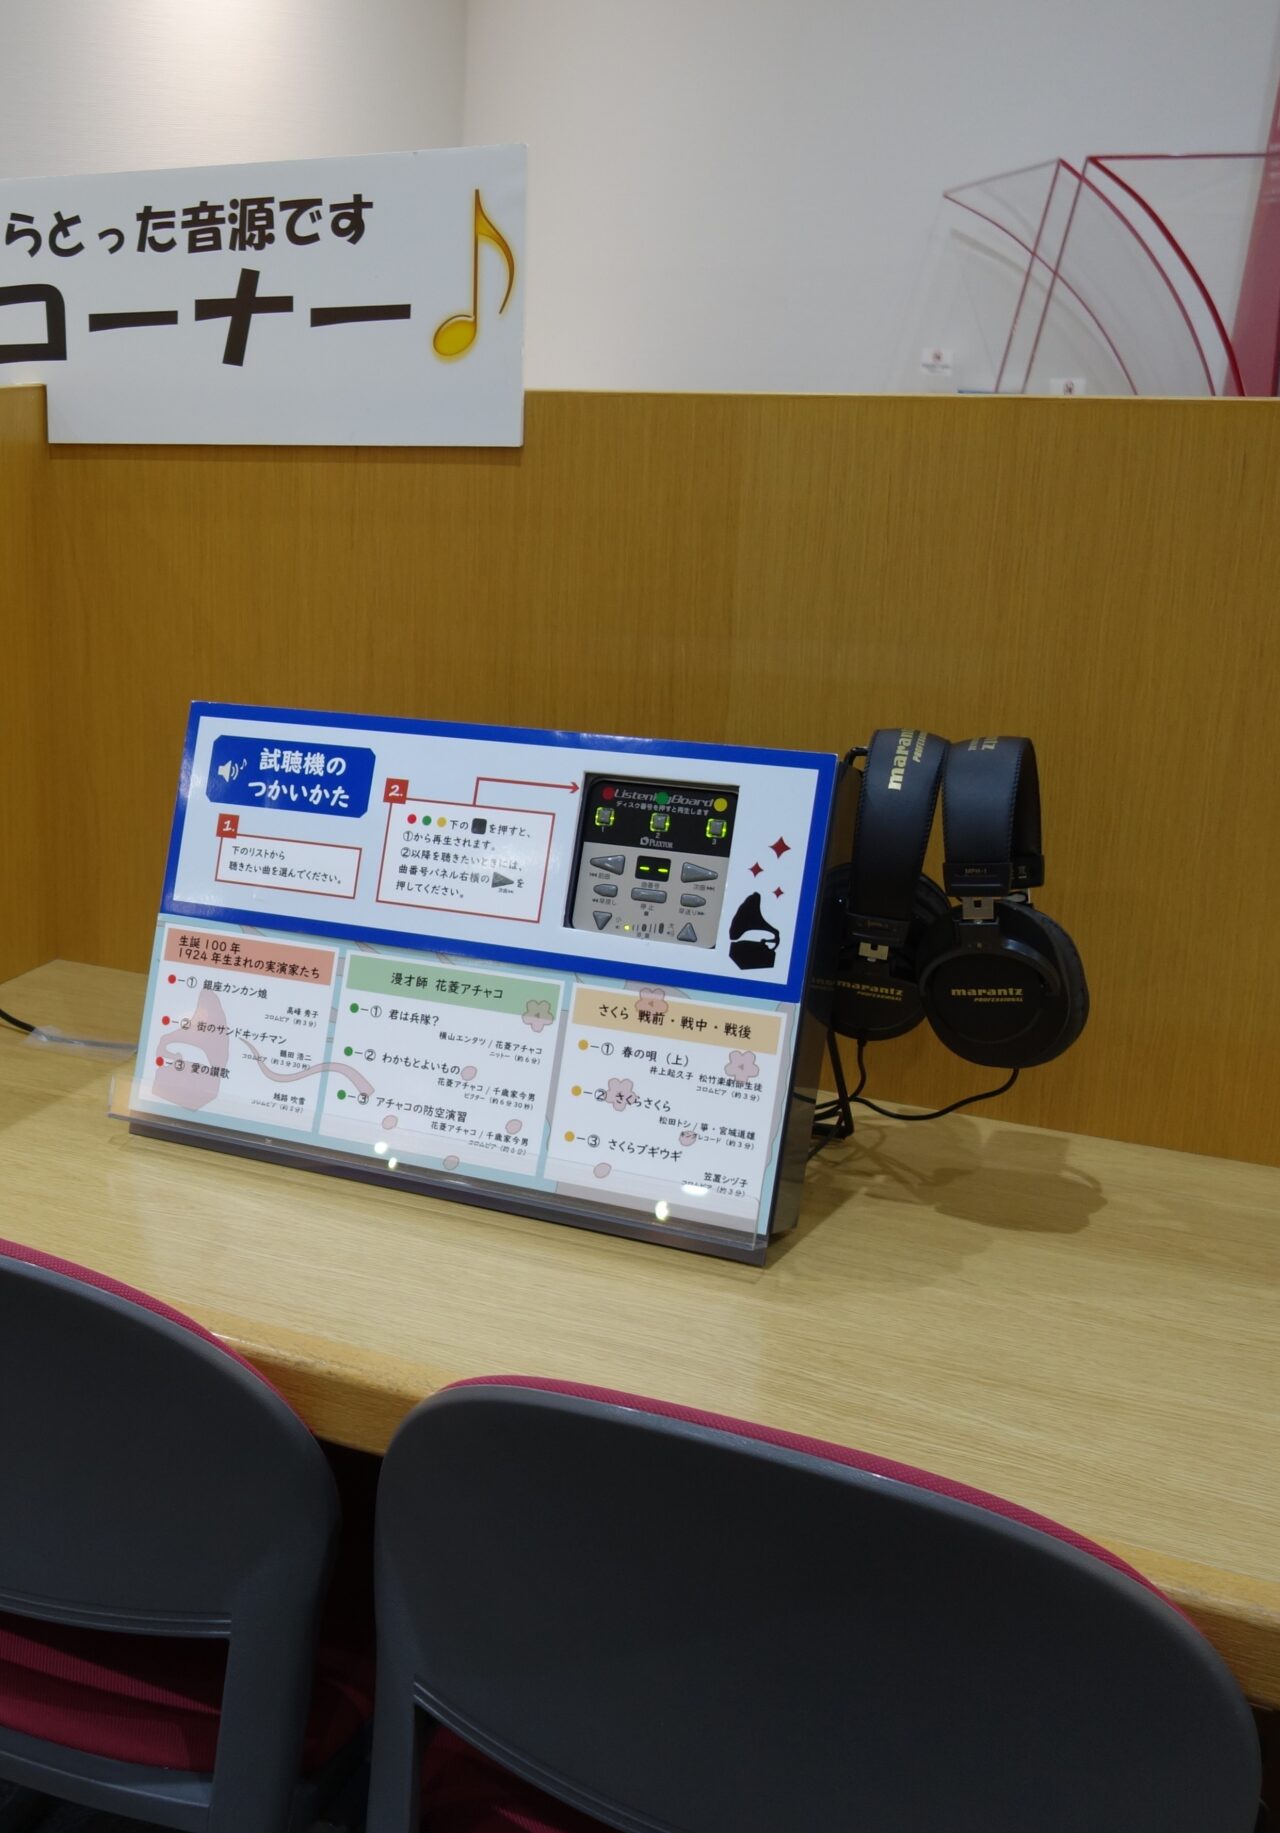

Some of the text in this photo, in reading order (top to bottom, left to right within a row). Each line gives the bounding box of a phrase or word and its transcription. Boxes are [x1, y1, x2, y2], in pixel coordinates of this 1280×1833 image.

[259, 748, 346, 776] 試聴機の
[888, 728, 915, 791] maran
[248, 780, 349, 808] つかいかた
[388, 785, 403, 797] 2.
[614, 789, 713, 807] ListeniBoard
[450, 820, 531, 838] 下の を押すと、
[403, 831, 495, 851] ①から再生されます。
[232, 845, 285, 860] 下のリストから
[400, 847, 522, 871] ②以降を聴きたいときには、
[229, 861, 341, 884] 聴きたい曲を選んでください。
[399, 864, 490, 884] 曲番号パネル右横の
[396, 880, 464, 898] 押してください。
[203, 979, 268, 1000] 銀座カンカン娘
[391, 972, 504, 1000] 漫才師 花菱アチャコ
[837, 980, 904, 997] marantz
[951, 987, 1024, 996] marantz
[598, 1004, 629, 1020] さくら
[439, 1031, 486, 1046] 横山エンタツ
[495, 1041, 543, 1055] 花菱アチャコ
[382, 1053, 461, 1076] わかもとよいもの
[437, 1077, 484, 1093] 花菱アチャコ
[493, 1087, 536, 1102] 千歳家今男
[375, 1096, 468, 1123] アチャコの防空演習
[615, 1092, 671, 1112] さくらさくら
[430, 1121, 477, 1137] 花菱アチャコ
[608, 1139, 682, 1162] さくらブギウギ
